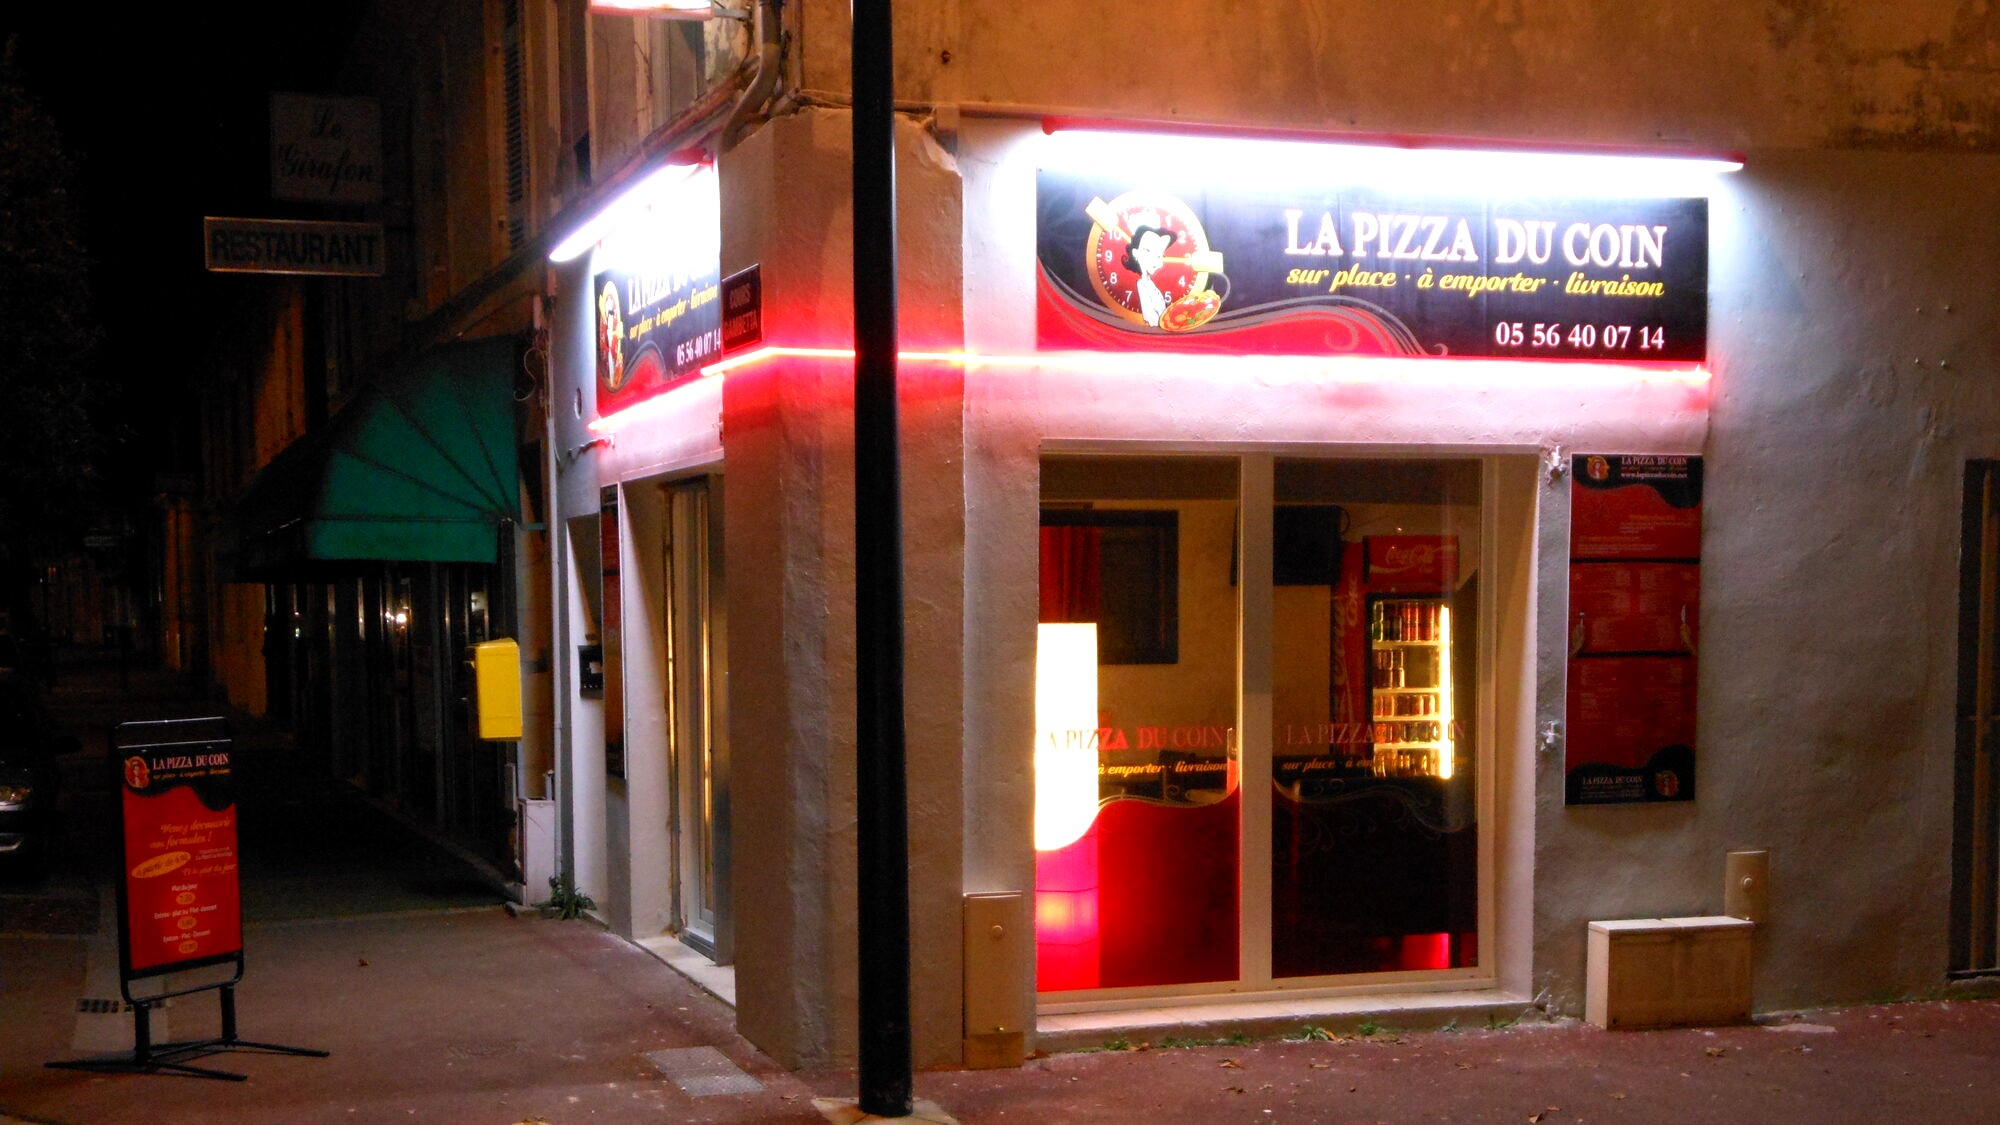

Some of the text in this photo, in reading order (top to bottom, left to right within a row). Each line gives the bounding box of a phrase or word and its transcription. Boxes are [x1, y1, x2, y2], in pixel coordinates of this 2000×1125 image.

[1284, 209, 1667, 267] LA PIZZA DU COIN
[211, 230, 376, 265] RESTAURANT
[1105, 250, 1113, 261] 9
[1110, 272, 1118, 284] 8
[1178, 276, 1186, 287] 4
[1287, 263, 1665, 297] sur place à emporter livraison
[1125, 291, 1132, 302] 7
[1164, 292, 1172, 303] 5
[1496, 322, 1664, 349] 05 56 40 07 14
[677, 327, 721, 365] 05 56 40 07 14
[1622, 456, 1631, 465] LA
[1633, 456, 1654, 465] PIZZA
[1066, 728, 1129, 750] PIZZA
[1137, 727, 1167, 749] DU
[1173, 726, 1225, 748] COIN
[1286, 723, 1375, 745] LA PIZZA
[152, 752, 229, 771] LA PIZZA DU COIN
[1108, 763, 1166, 778] emporter
[1175, 761, 1227, 773] livraison
[1282, 761, 1301, 770] sur
[1302, 758, 1337, 773] place
